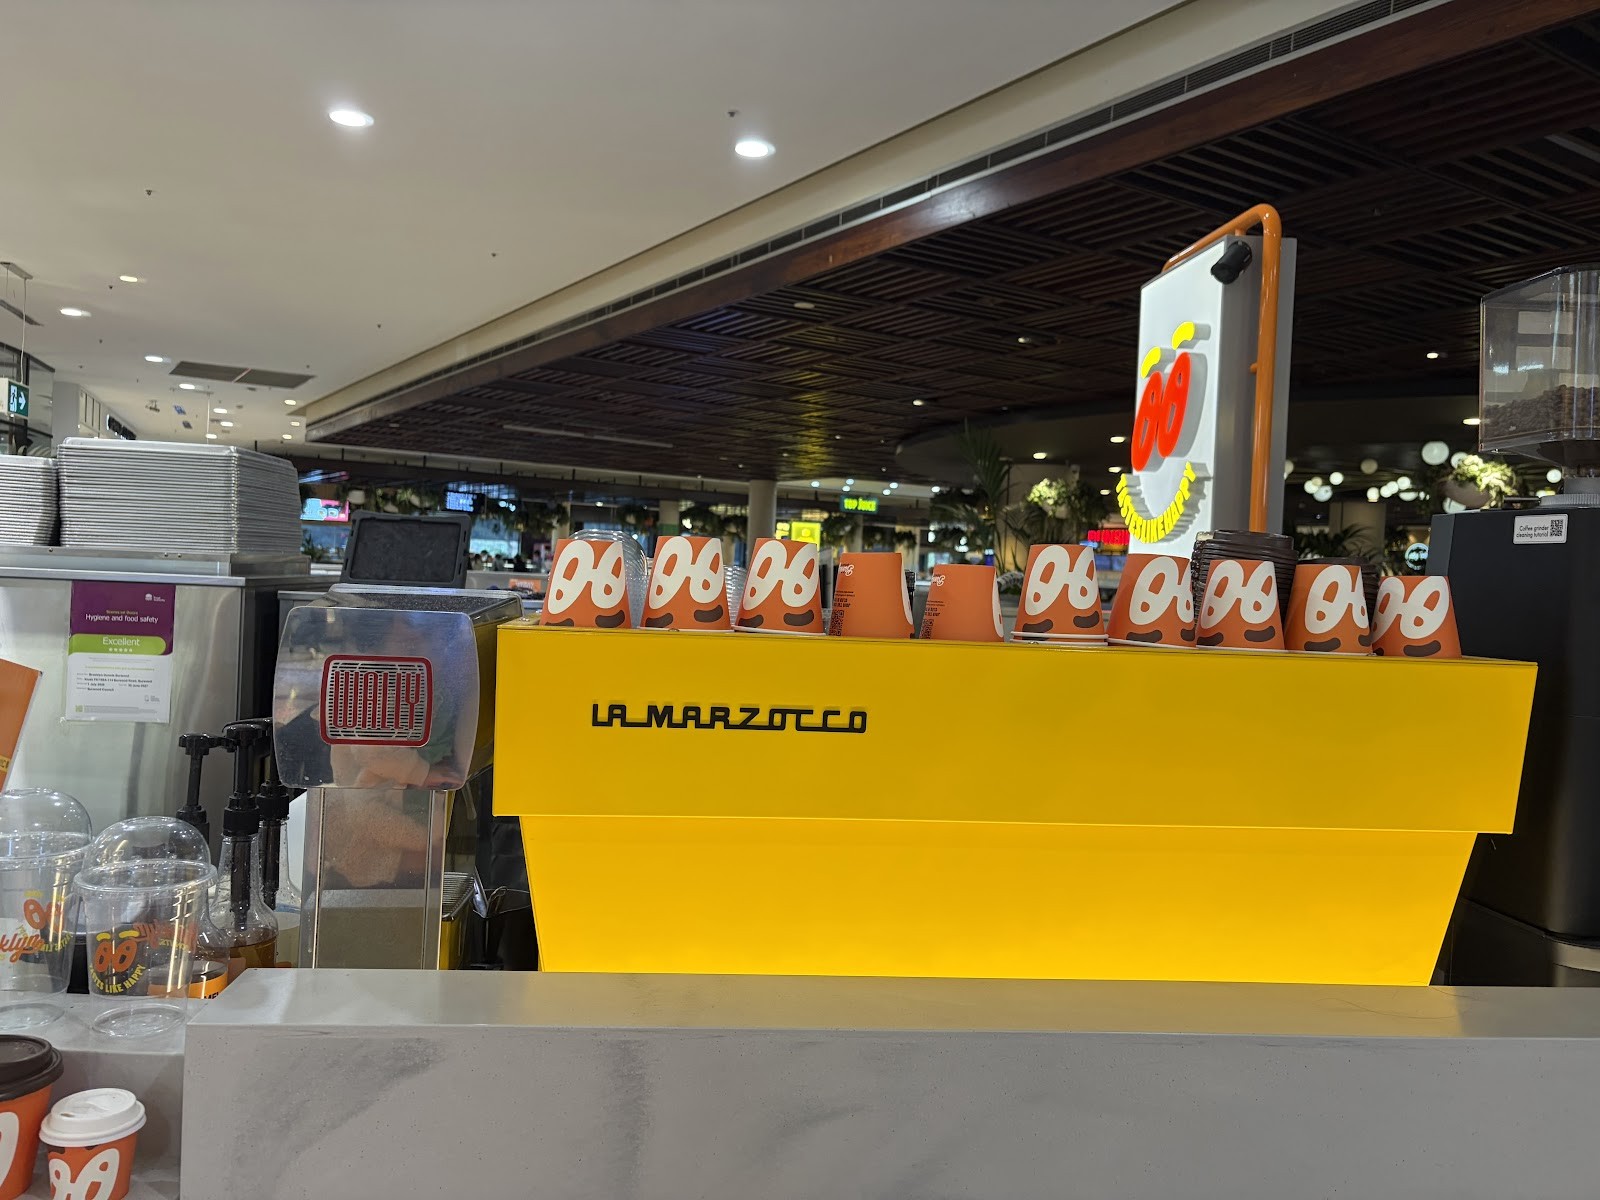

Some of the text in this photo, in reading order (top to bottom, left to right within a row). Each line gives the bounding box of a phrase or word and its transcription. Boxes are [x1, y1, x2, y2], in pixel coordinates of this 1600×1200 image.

[1116, 461, 1196, 544] TASTES LIKE HAPPY
[85, 613, 110, 622] Hygiene
[140, 616, 159, 624] safety
[102, 637, 140, 646] Excellent
[591, 703, 867, 733] LA MARZOCCO
[105, 983, 124, 994] LIKE
[123, 964, 146, 989] HAPPY
